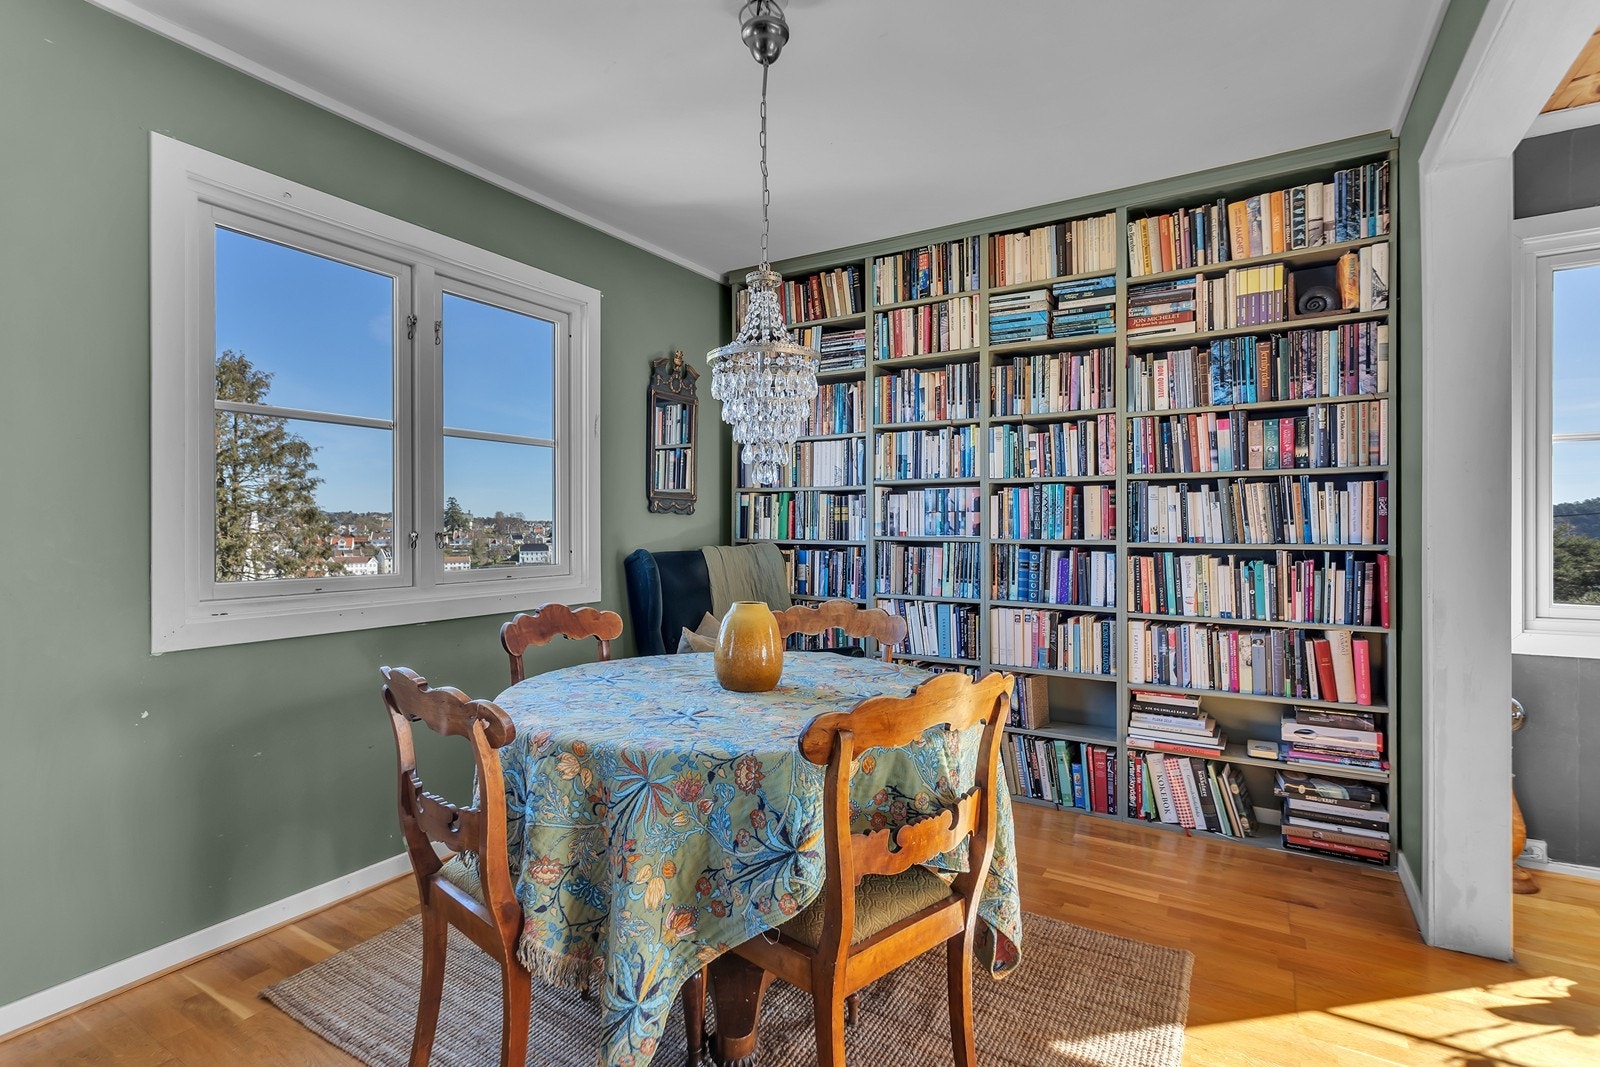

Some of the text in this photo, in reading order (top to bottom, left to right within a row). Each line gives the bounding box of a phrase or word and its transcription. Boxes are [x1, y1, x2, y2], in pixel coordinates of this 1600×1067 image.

[1234, 226, 1244, 255] MAGNET
[1147, 313, 1180, 322] MICHELET
[1157, 365, 1165, 398] DON QUIJOTE
[1260, 349, 1270, 388] Jernbyrden
[1156, 773, 1172, 815] KOKEBOK
